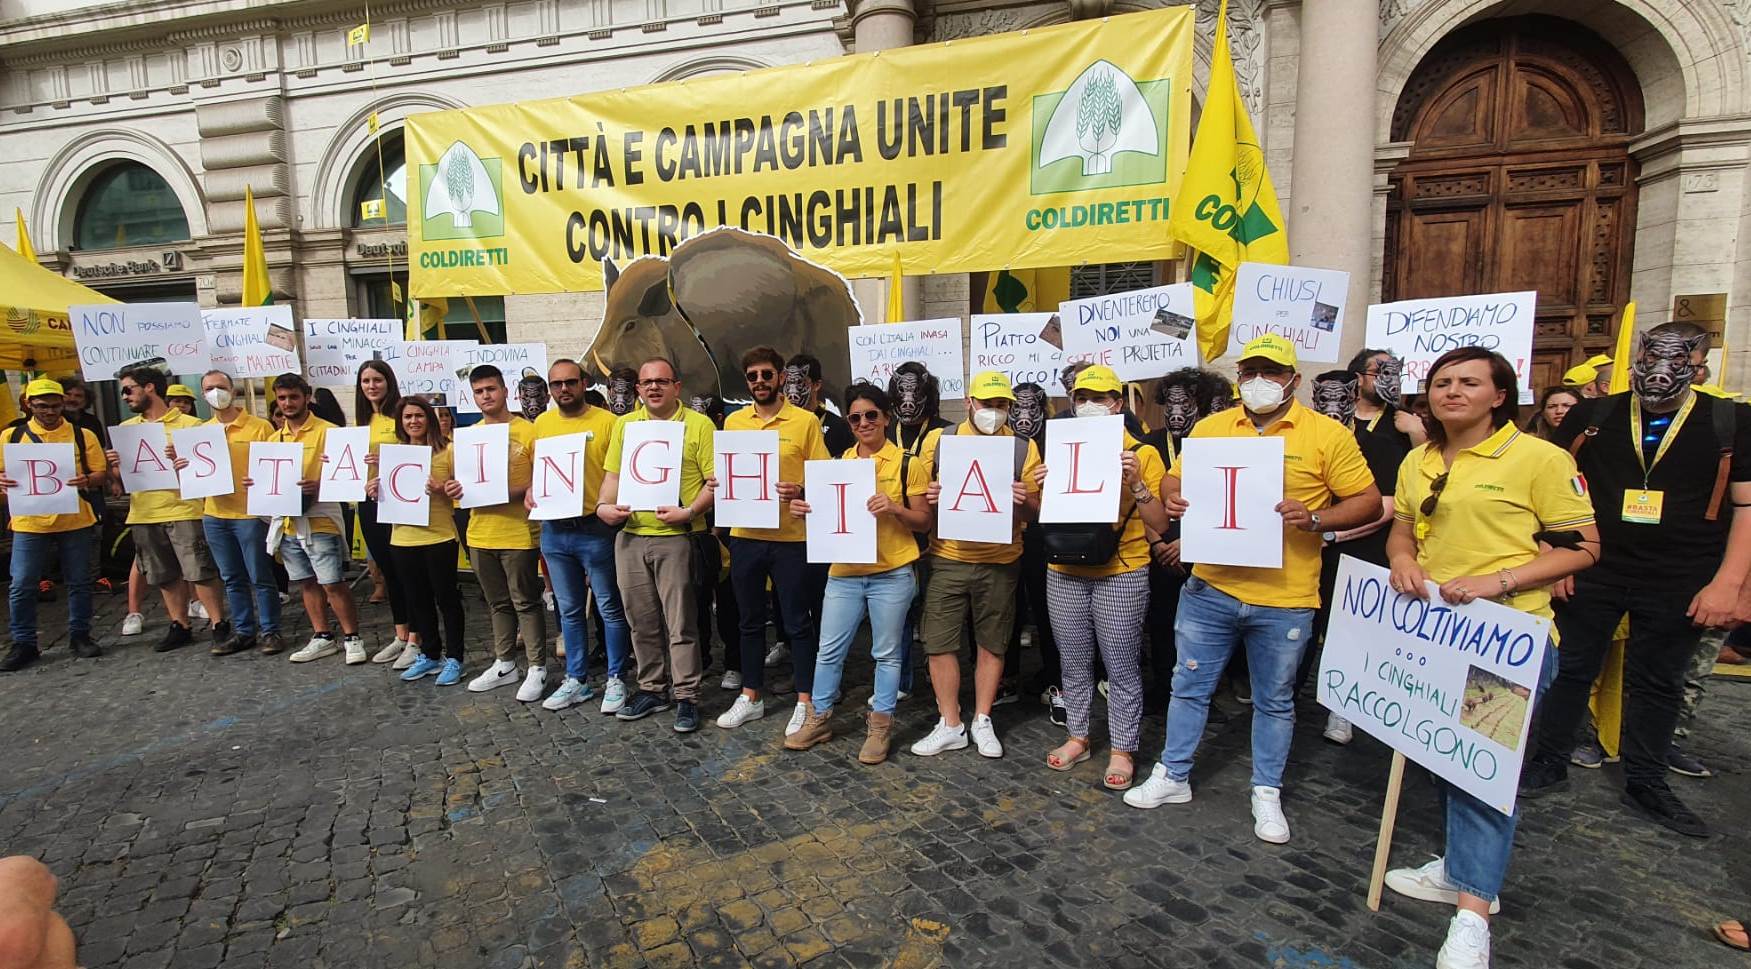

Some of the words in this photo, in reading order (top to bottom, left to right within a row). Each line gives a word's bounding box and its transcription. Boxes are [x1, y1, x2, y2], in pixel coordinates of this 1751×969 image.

[518, 122, 615, 194] CITTÀ
[624, 131, 644, 186] E
[655, 104, 863, 182] CAMPAGNA
[877, 85, 1008, 161] UNITE
[566, 200, 705, 263] CONTRO
[741, 181, 943, 250] CINGHIALI
[1026, 197, 1170, 231] COLDIRETTI
[73, 262, 125, 277] Deutsche
[126, 258, 158, 273] Bank
[420, 247, 508, 269] COLDIRETTI
[1257, 274, 1322, 302] CHIUSI
[1079, 292, 1171, 326] DIVENTEREMO
[1384, 302, 1518, 336] DIFENDIAMO
[83, 311, 126, 336] NON
[201, 315, 251, 331] FERMATE
[309, 322, 318, 336] I
[327, 321, 392, 334] CINGHIALI
[856, 333, 876, 346] CON
[920, 330, 948, 341] INVASA
[1095, 326, 1121, 343] NOI
[1128, 328, 1151, 338] UNA
[1414, 333, 1500, 353] NOSTRO
[82, 344, 160, 366] CONTINUARE
[247, 355, 295, 375] MALATTIE
[464, 348, 528, 365] INDOVINA
[868, 349, 888, 361] DAI
[978, 353, 1015, 367] RICCO
[1029, 353, 1039, 363] MI
[19, 459, 63, 496] B
[129, 438, 169, 474] A
[192, 441, 216, 478] S
[258, 458, 294, 496] T
[329, 443, 361, 481] A
[388, 463, 423, 503] C
[472, 443, 489, 483] I
[539, 451, 580, 498] N
[629, 440, 676, 484] G
[719, 452, 775, 500] H
[827, 482, 854, 534] I
[947, 457, 1003, 513] A
[1058, 441, 1105, 494] L
[1211, 466, 1249, 530] I
[1343, 575, 1388, 624] NOI
[1392, 592, 1534, 667] COLTIVIAMO
[1364, 652, 1369, 672] I
[1378, 661, 1457, 718] CINGHIALI
[1325, 669, 1497, 780] RACCOLGONO
